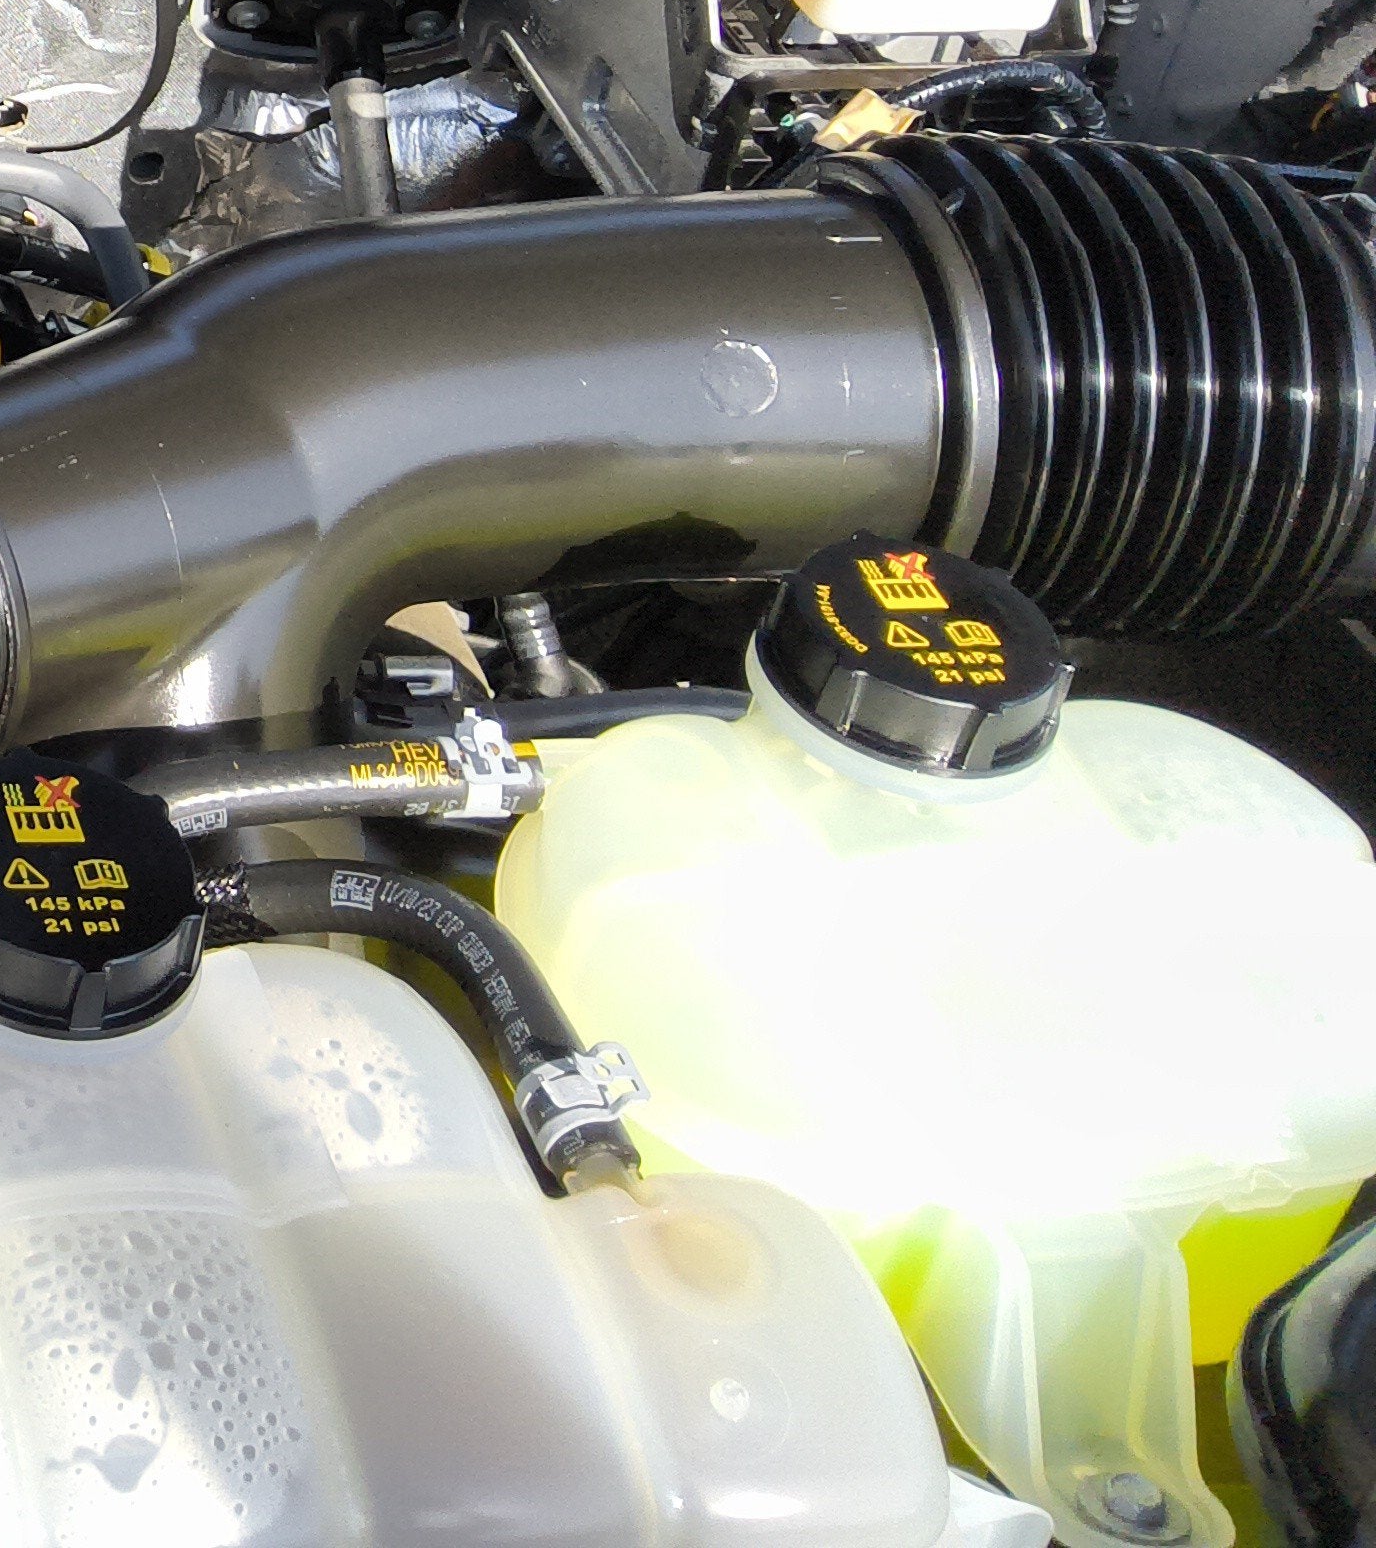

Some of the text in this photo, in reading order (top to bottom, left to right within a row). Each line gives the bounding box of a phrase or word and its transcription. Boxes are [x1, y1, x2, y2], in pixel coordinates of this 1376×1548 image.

[911, 650, 1005, 666] 145 kPa
[934, 668, 1007, 686] 21 psi
[390, 740, 439, 763] HEV
[25, 895, 126, 912] 145 kPa
[44, 917, 120, 936] 21 psi
